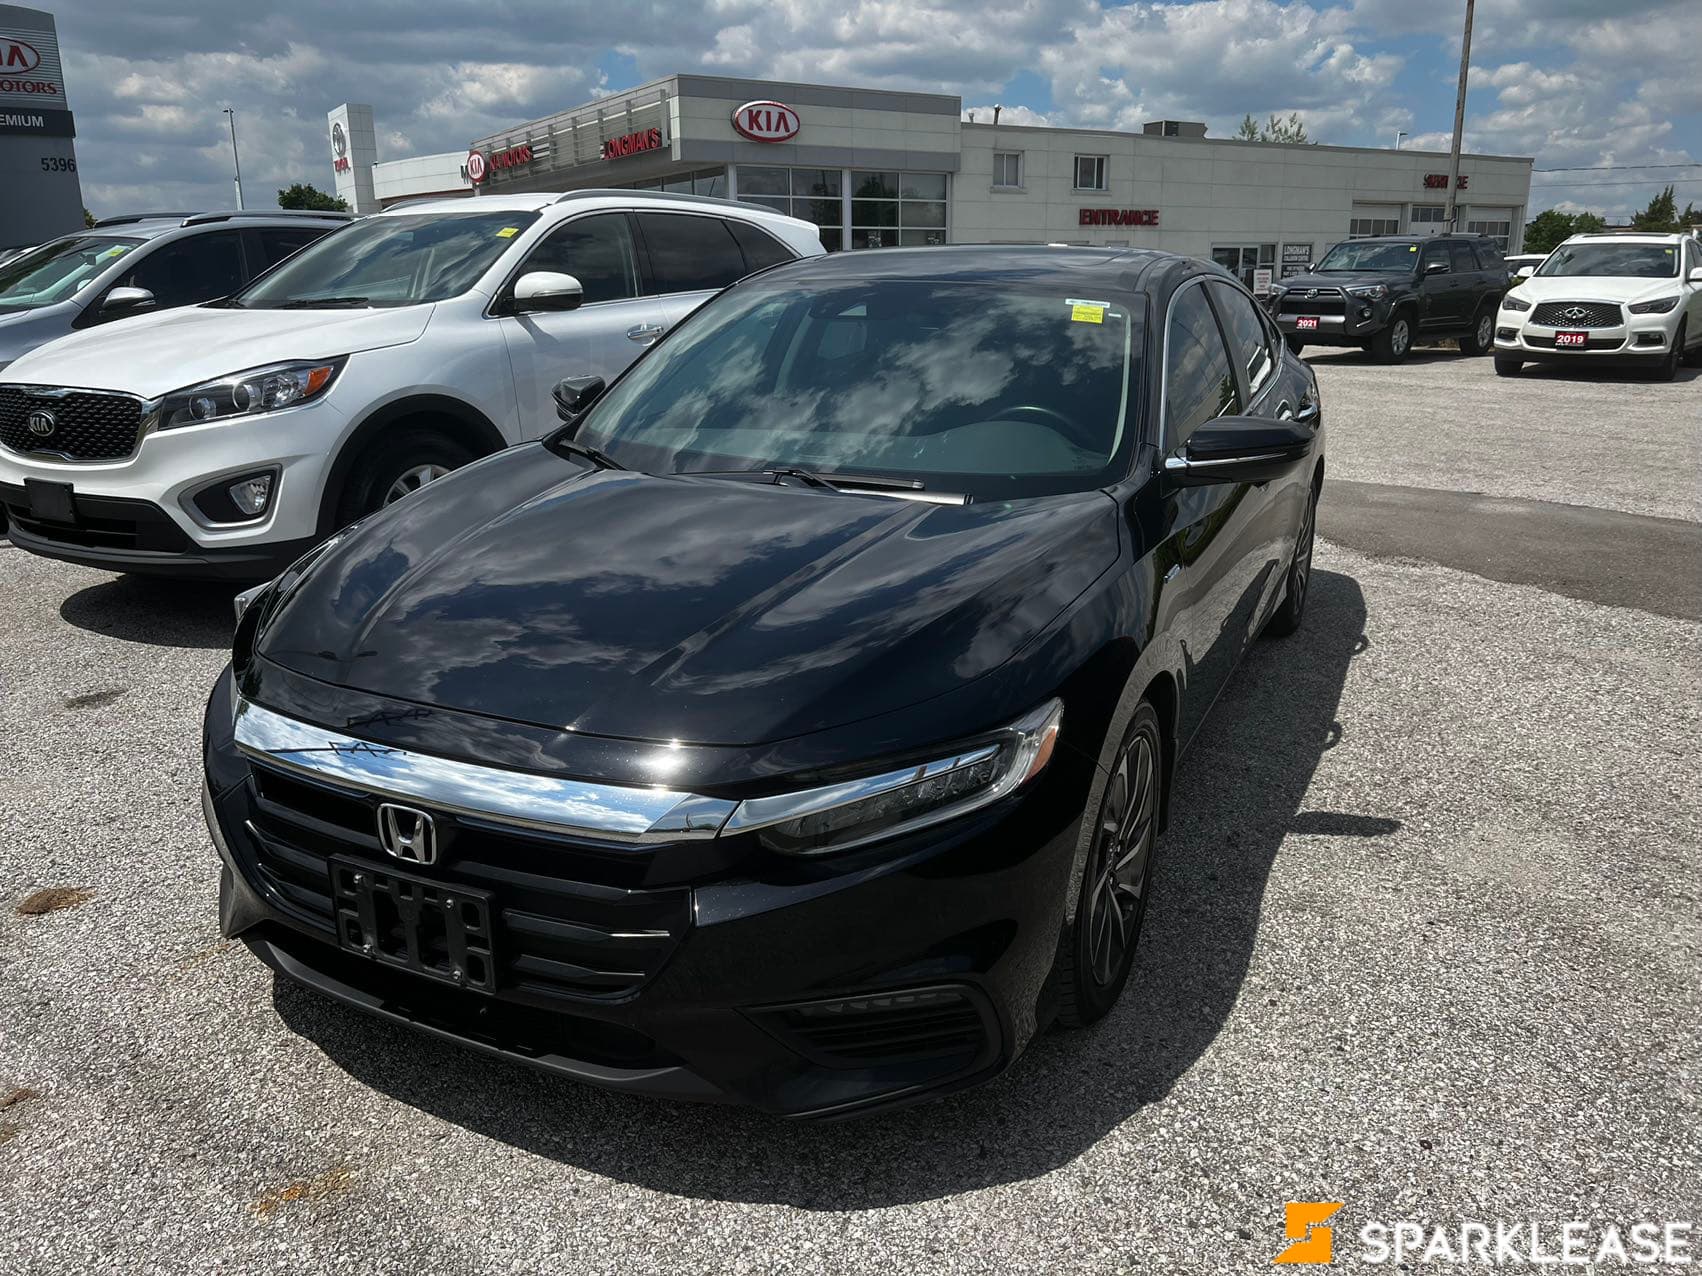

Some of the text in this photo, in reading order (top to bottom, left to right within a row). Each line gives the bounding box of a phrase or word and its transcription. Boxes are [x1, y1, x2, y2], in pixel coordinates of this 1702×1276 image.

[0, 80, 57, 94] OTORS
[748, 109, 790, 132] KIA
[604, 128, 660, 160] LONGMAN'S
[41, 157, 76, 172] 5396
[470, 158, 483, 175] KIA
[1079, 208, 1160, 226] ENTRANCE
[1297, 319, 1317, 327] 2021
[1556, 335, 1584, 343] 2019
[29, 416, 50, 432] KIA
